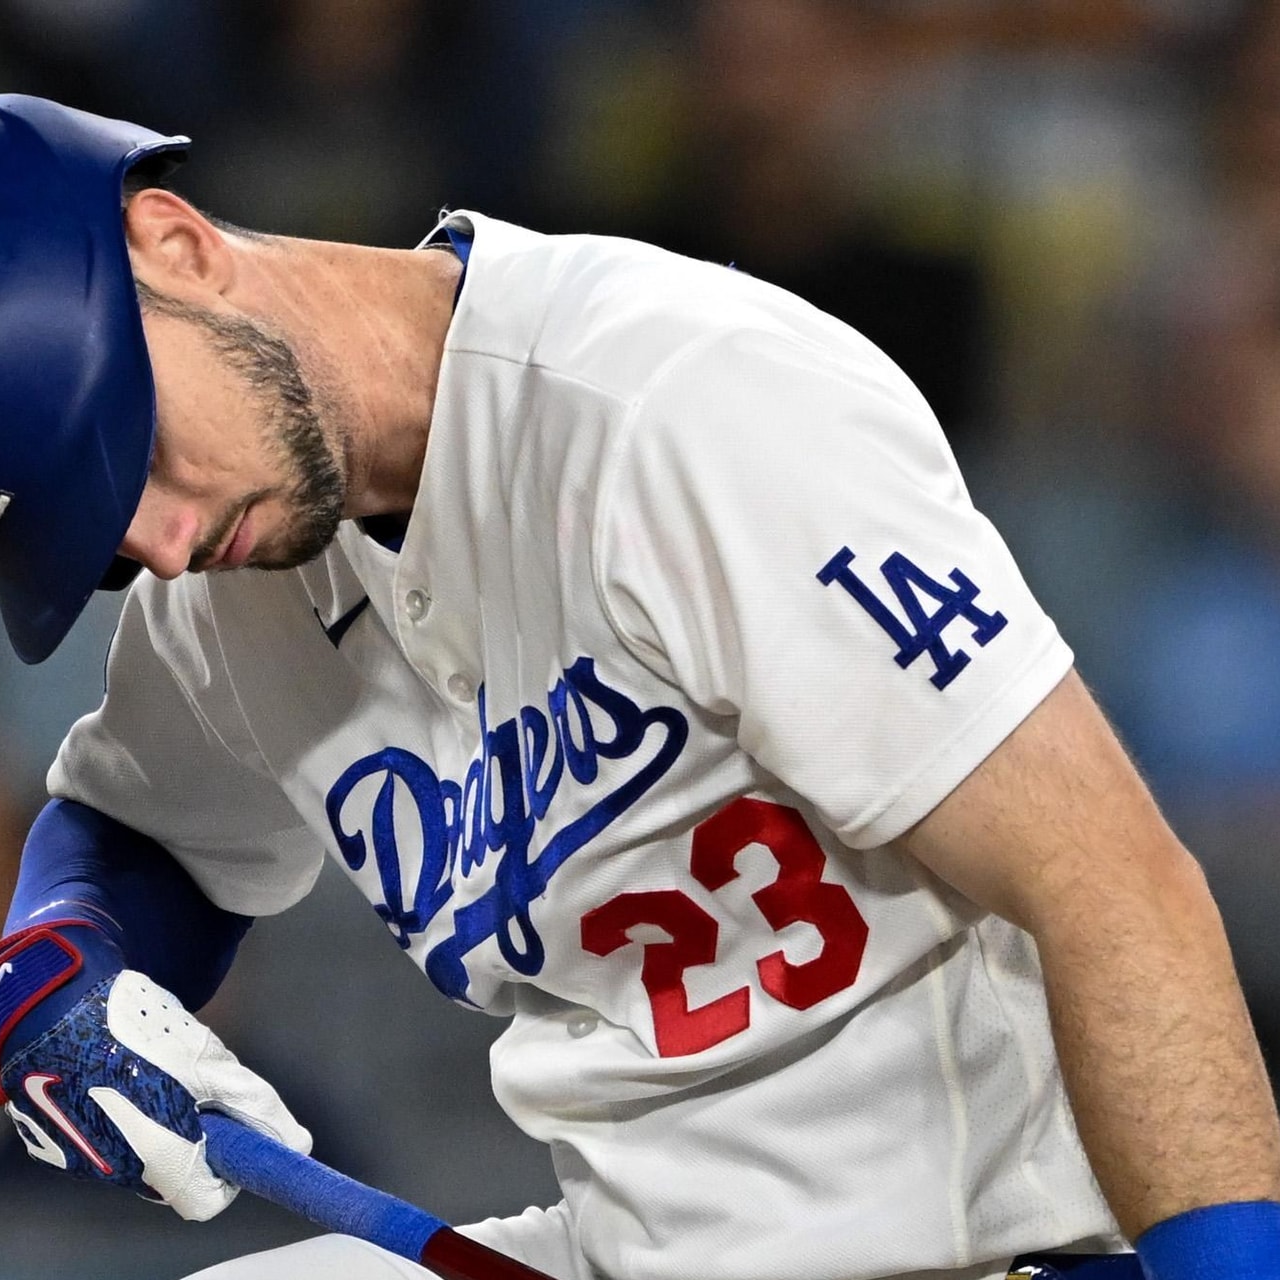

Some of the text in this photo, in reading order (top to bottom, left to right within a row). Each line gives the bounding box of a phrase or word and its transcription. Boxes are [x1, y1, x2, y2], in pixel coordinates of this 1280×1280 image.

[815, 545, 1009, 692] LA
[324, 655, 690, 1011] Dodgers
[580, 795, 870, 1059] 23
